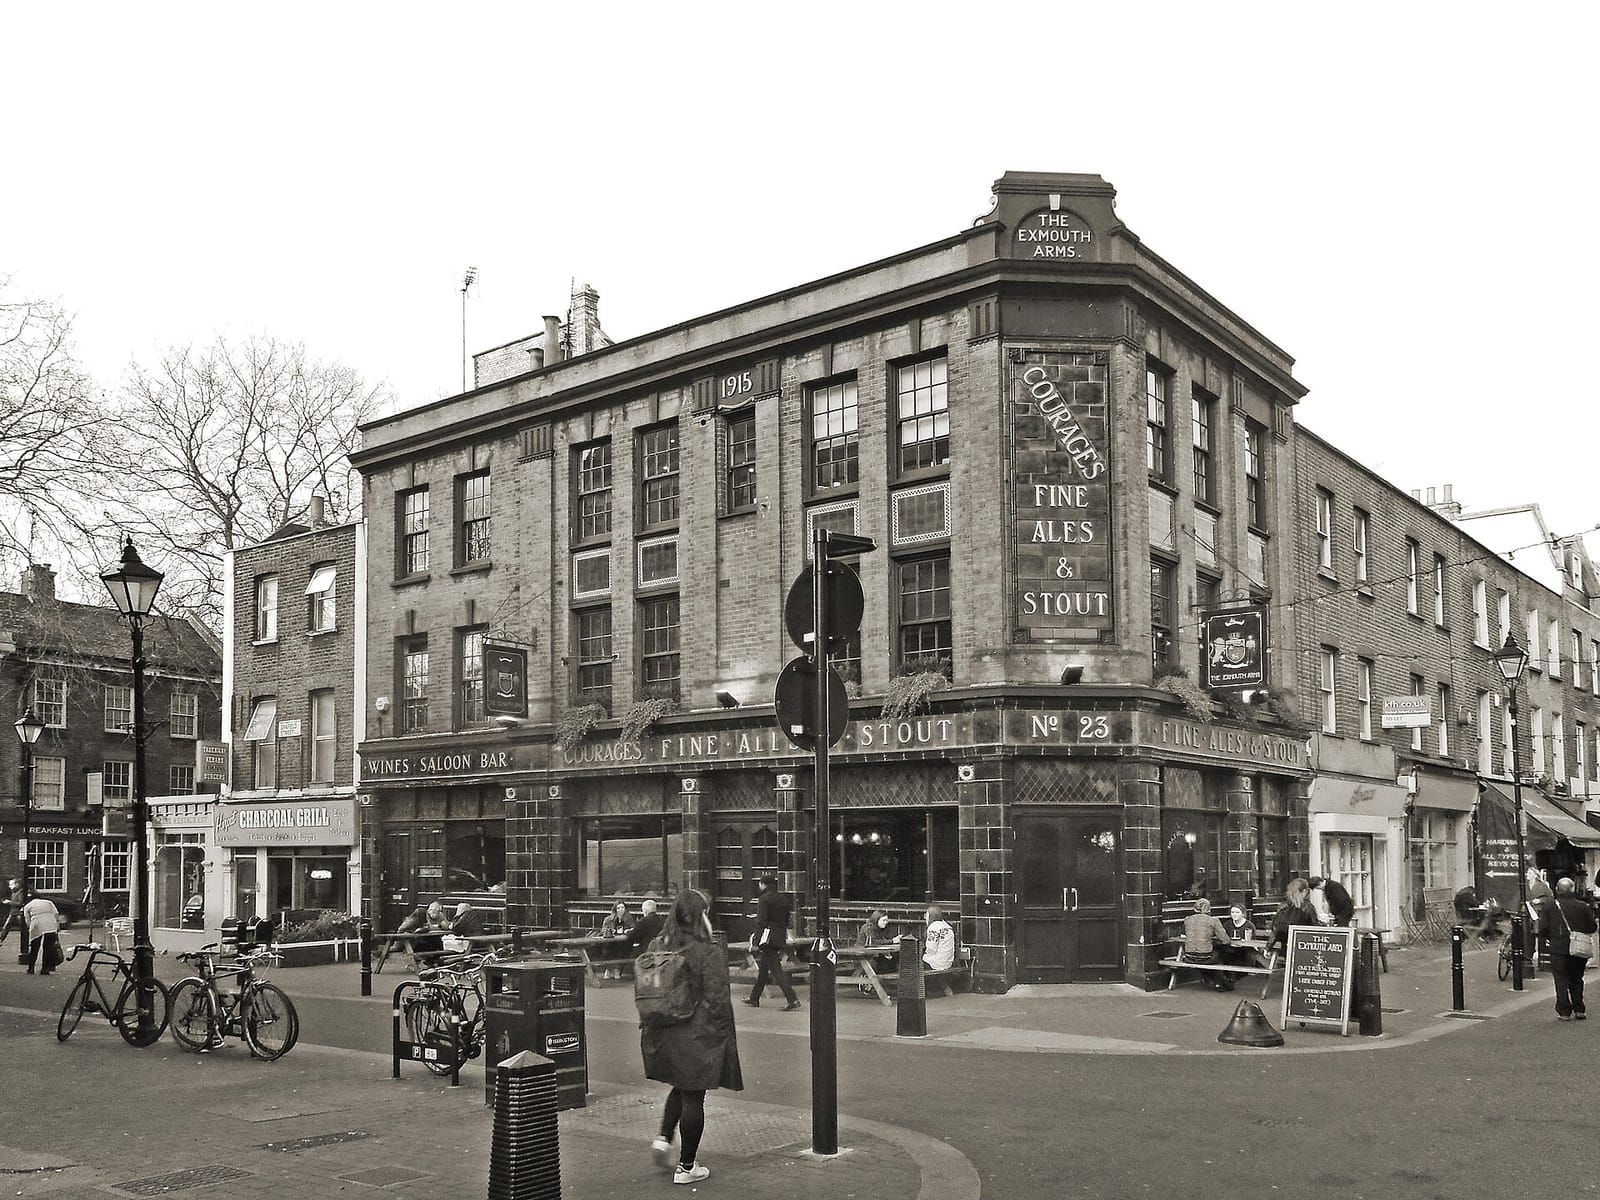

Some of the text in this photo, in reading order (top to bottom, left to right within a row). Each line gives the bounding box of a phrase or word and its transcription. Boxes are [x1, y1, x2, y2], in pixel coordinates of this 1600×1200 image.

[1038, 214, 1069, 227] THE
[1018, 229, 1091, 242] EXMOUTH
[1033, 245, 1081, 258] ARMS.
[721, 372, 753, 398] 1915
[1023, 367, 1106, 480] COURAGES
[1035, 485, 1089, 508] FINE
[1031, 521, 1094, 544] ALES
[1056, 557, 1073, 578] &
[1023, 592, 1108, 616] STOUT
[1080, 716, 1109, 738] 23
[564, 742, 642, 764] COURAGES
[661, 735, 719, 758] FINE
[861, 719, 952, 746] STOUT
[1162, 722, 1299, 764] FINE ALES & STOUT
[368, 752, 508, 774] WINES SALOON BAR
[239, 809, 295, 829] CHARCOAL
[297, 807, 330, 827] GRILL
[1298, 942, 1327, 952] EXMOUTH
